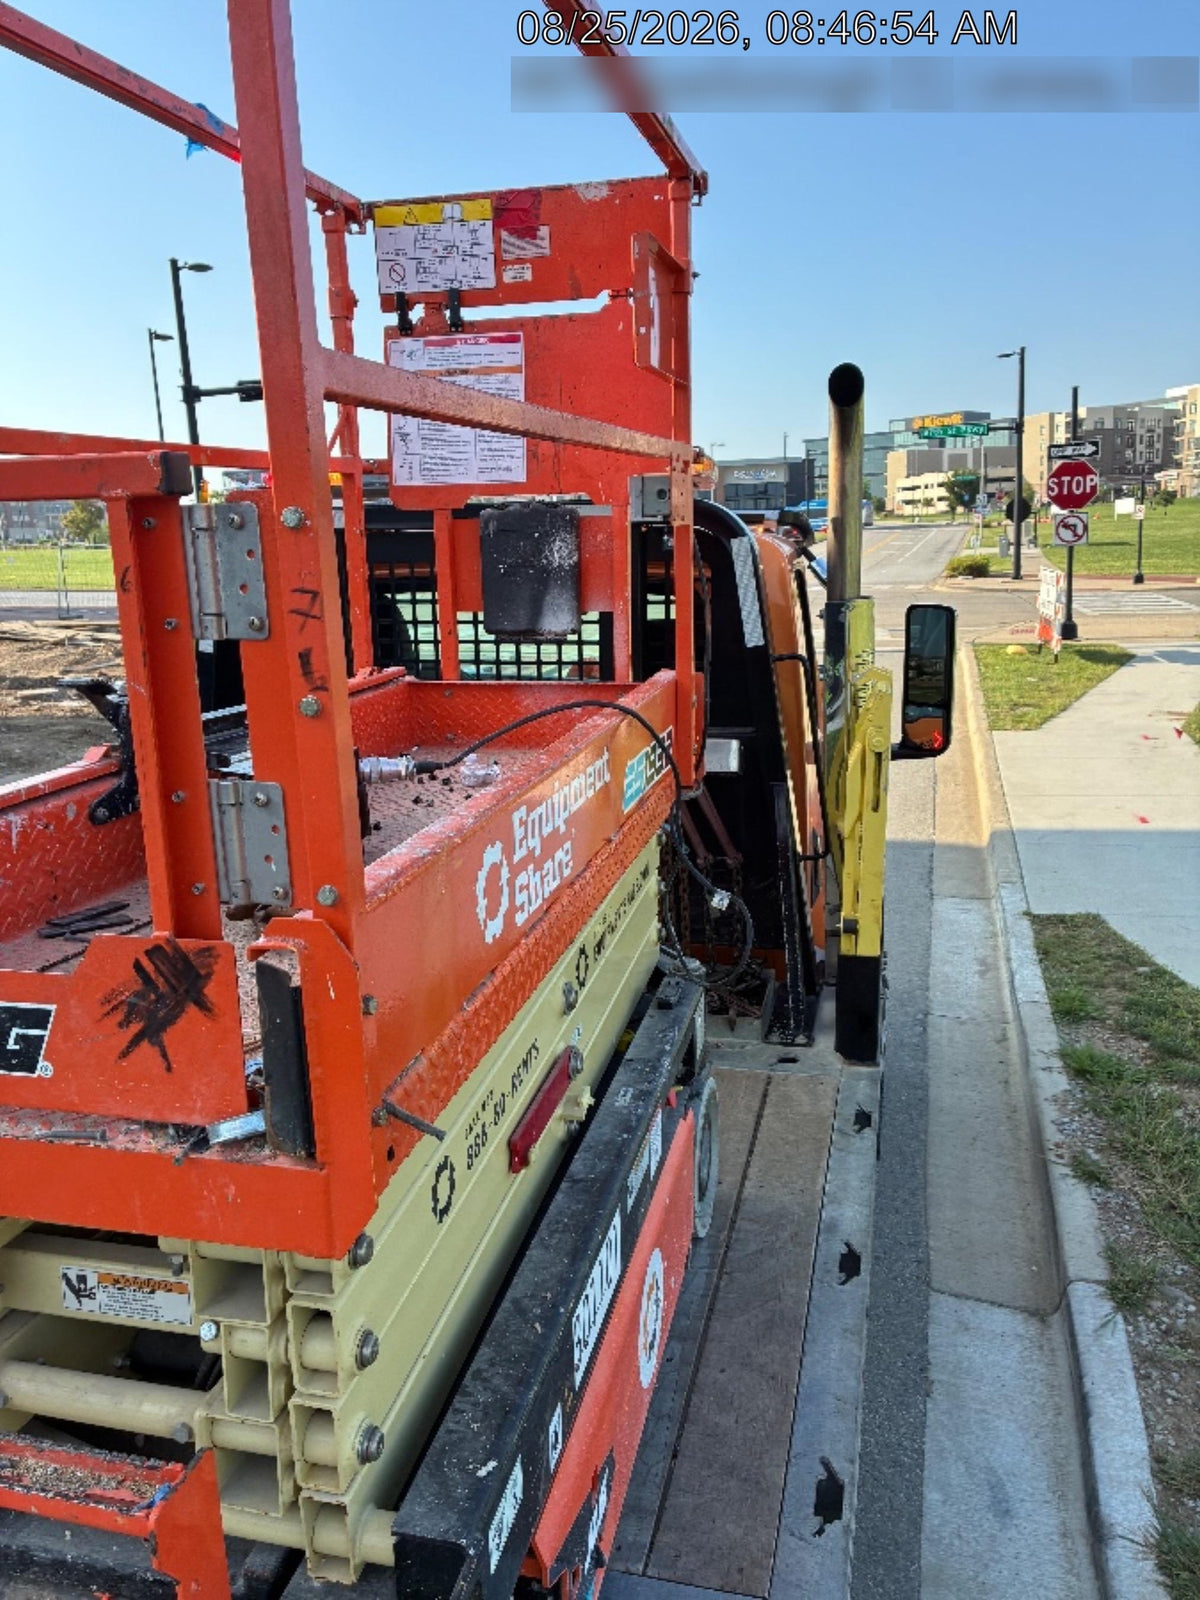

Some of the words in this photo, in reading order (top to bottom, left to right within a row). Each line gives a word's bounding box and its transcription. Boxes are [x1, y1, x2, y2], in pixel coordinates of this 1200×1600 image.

[1048, 474, 1097, 497] STOP
[512, 746, 610, 864] Equipment
[515, 840, 574, 927] Share
